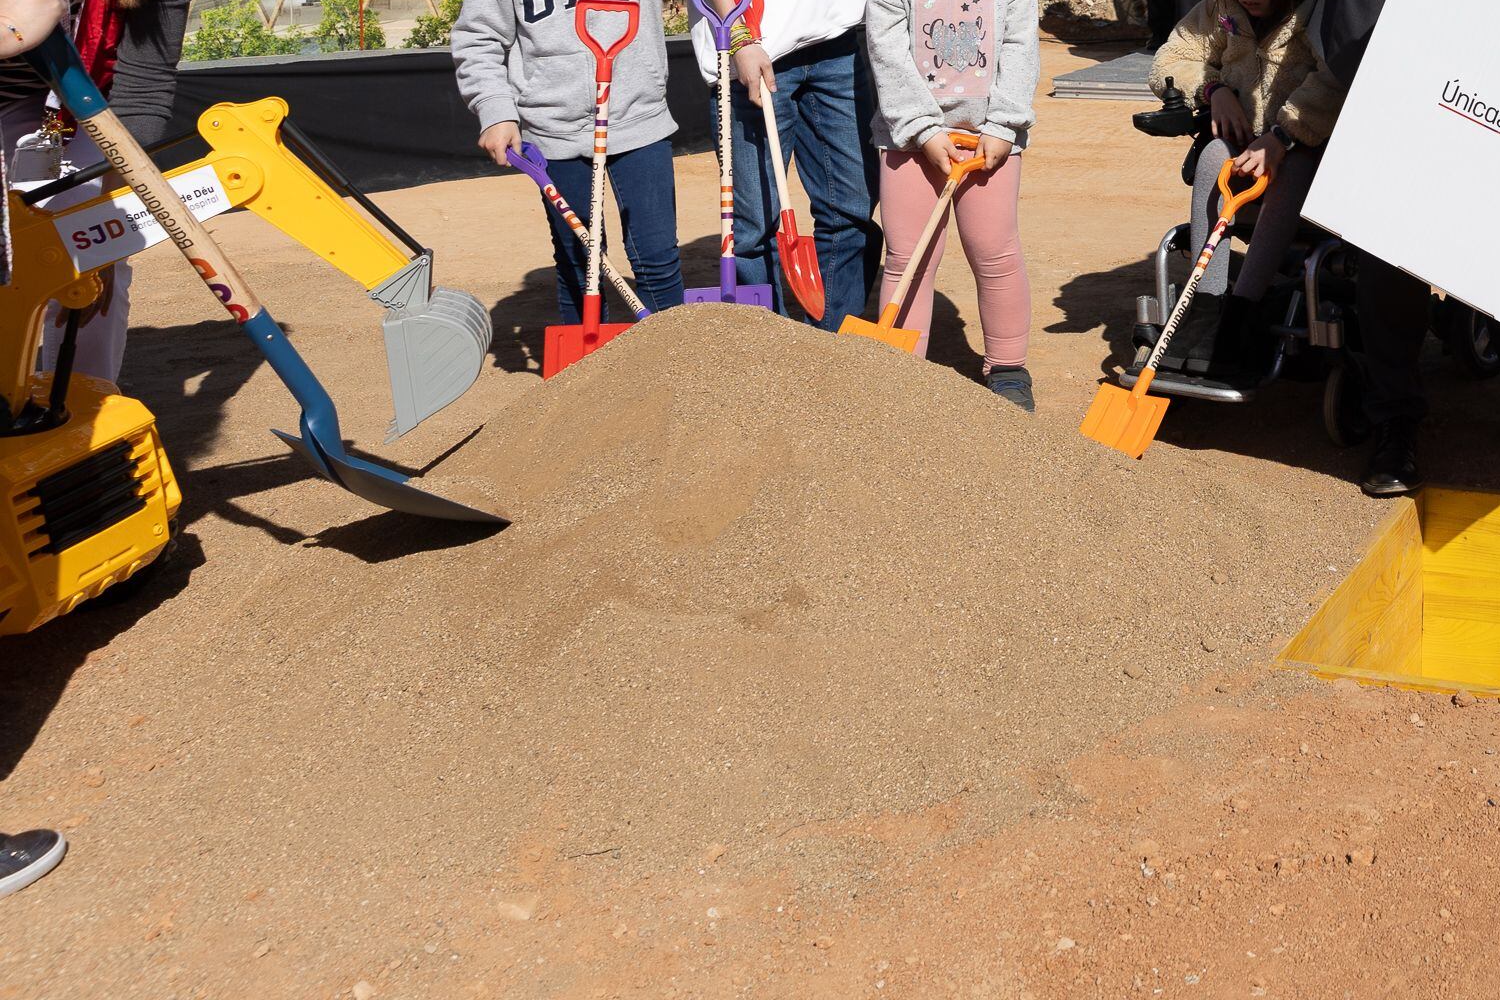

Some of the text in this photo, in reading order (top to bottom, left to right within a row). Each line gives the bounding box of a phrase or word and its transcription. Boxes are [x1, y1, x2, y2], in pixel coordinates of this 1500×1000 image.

[72, 218, 125, 251] SJD
[194, 186, 215, 199] Déu
[131, 194, 219, 232] Barce ospital
[134, 183, 194, 250] Barcelona
